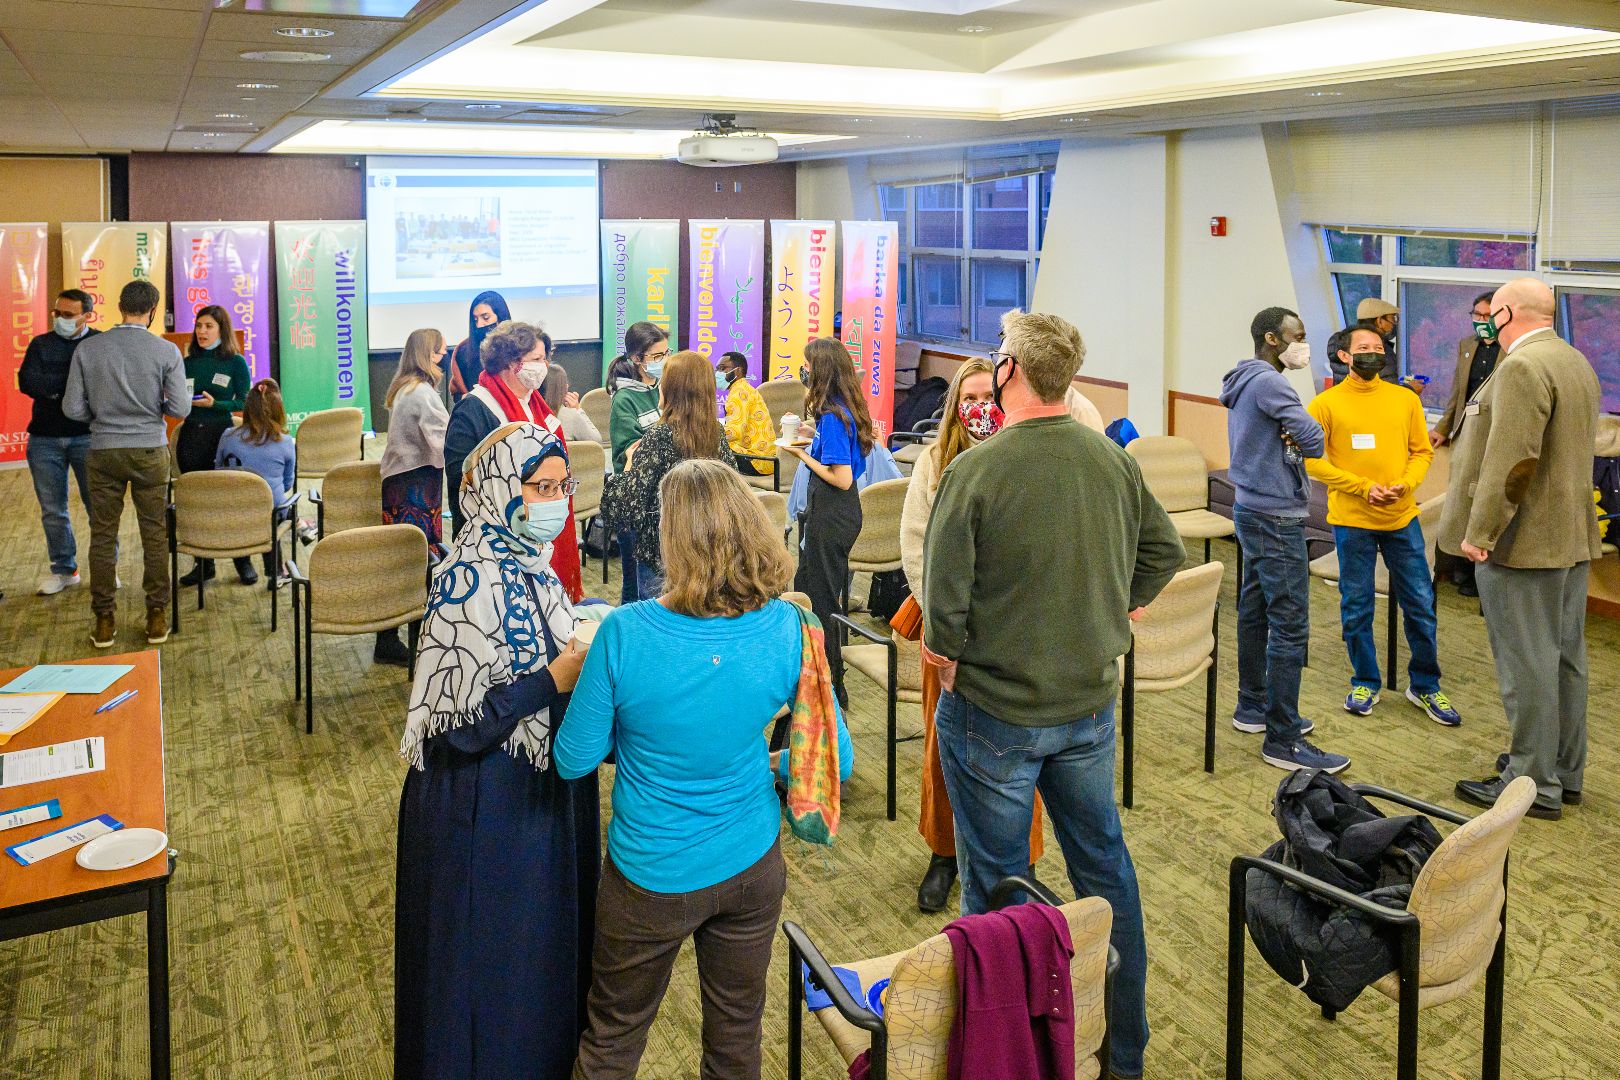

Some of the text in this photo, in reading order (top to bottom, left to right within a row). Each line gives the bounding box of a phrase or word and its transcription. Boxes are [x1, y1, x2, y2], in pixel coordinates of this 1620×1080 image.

[133, 232, 151, 282] malig
[612, 233, 630, 282] добро
[334, 249, 356, 399] willkommen
[871, 235, 889, 396] barka da zuwa
